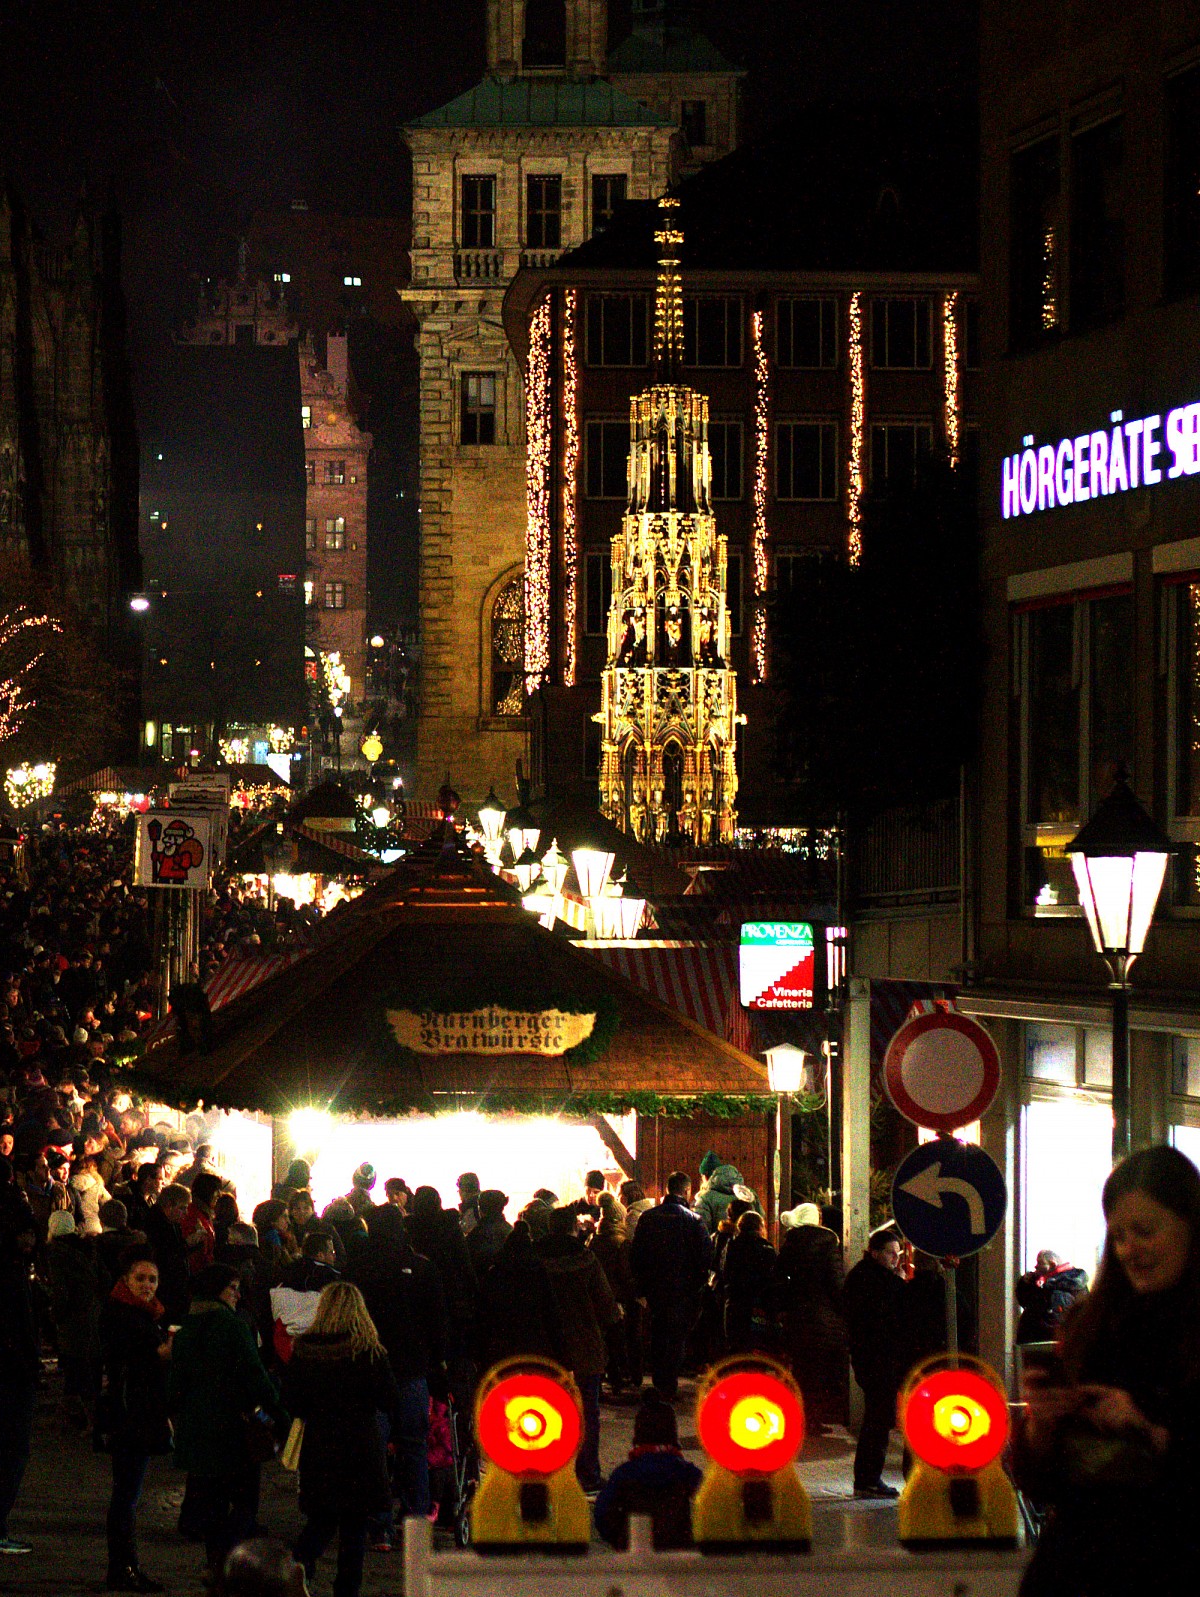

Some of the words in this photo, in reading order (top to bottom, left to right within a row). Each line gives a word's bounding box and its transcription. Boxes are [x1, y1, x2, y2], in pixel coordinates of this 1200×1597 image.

[1002, 409, 1161, 519] HÖRGERÄTE
[1165, 402, 1200, 479] SE
[741, 923, 813, 939] PROVENZA
[772, 987, 813, 998] Vineria
[757, 998, 813, 1009] Cafetteria
[419, 1028, 563, 1048] Bratwürste
